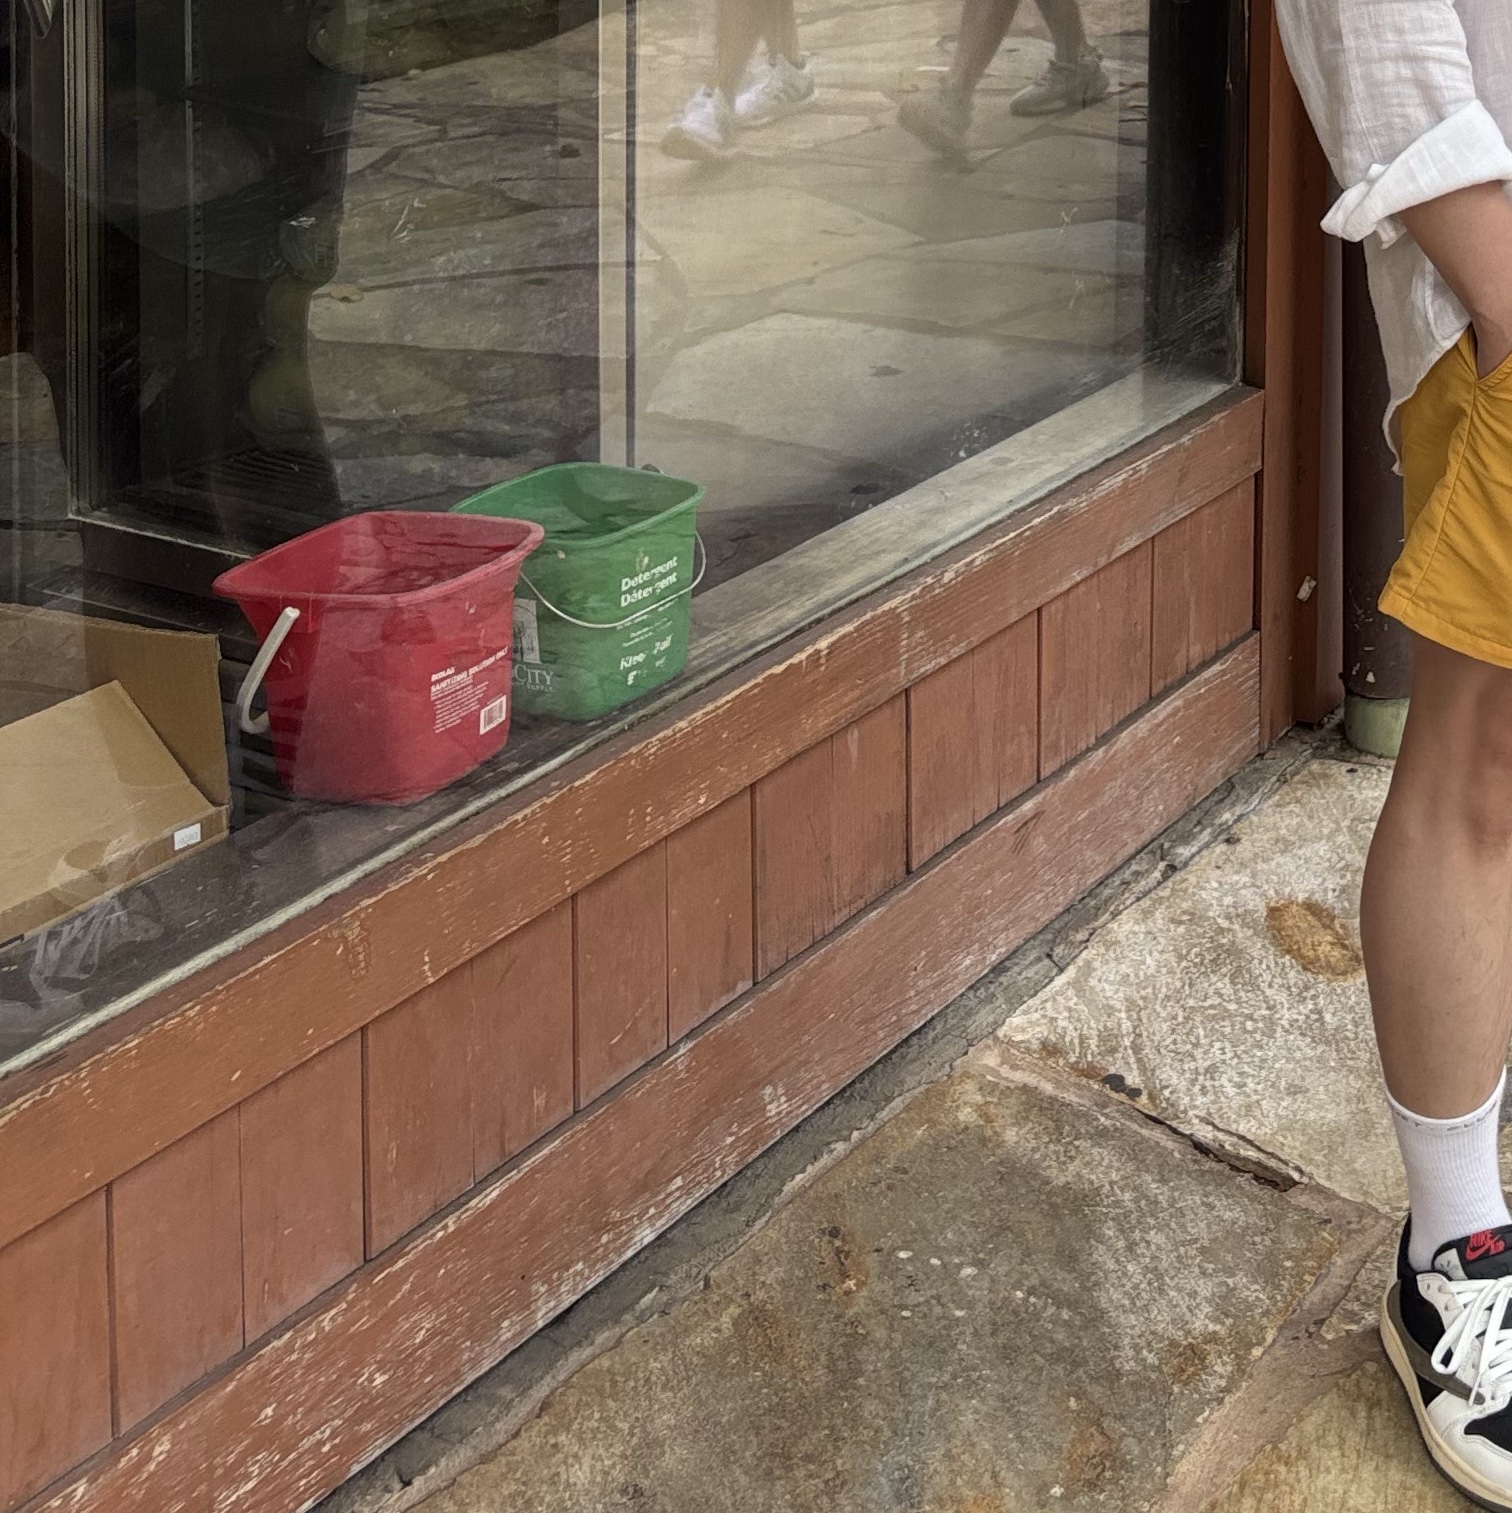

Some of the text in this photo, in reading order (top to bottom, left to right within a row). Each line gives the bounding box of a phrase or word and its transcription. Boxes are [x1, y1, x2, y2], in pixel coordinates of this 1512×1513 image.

[621, 556, 678, 592] Detergent
[1470, 1228, 1493, 1247] NIKE
[1489, 1240, 1506, 1256] AIR
